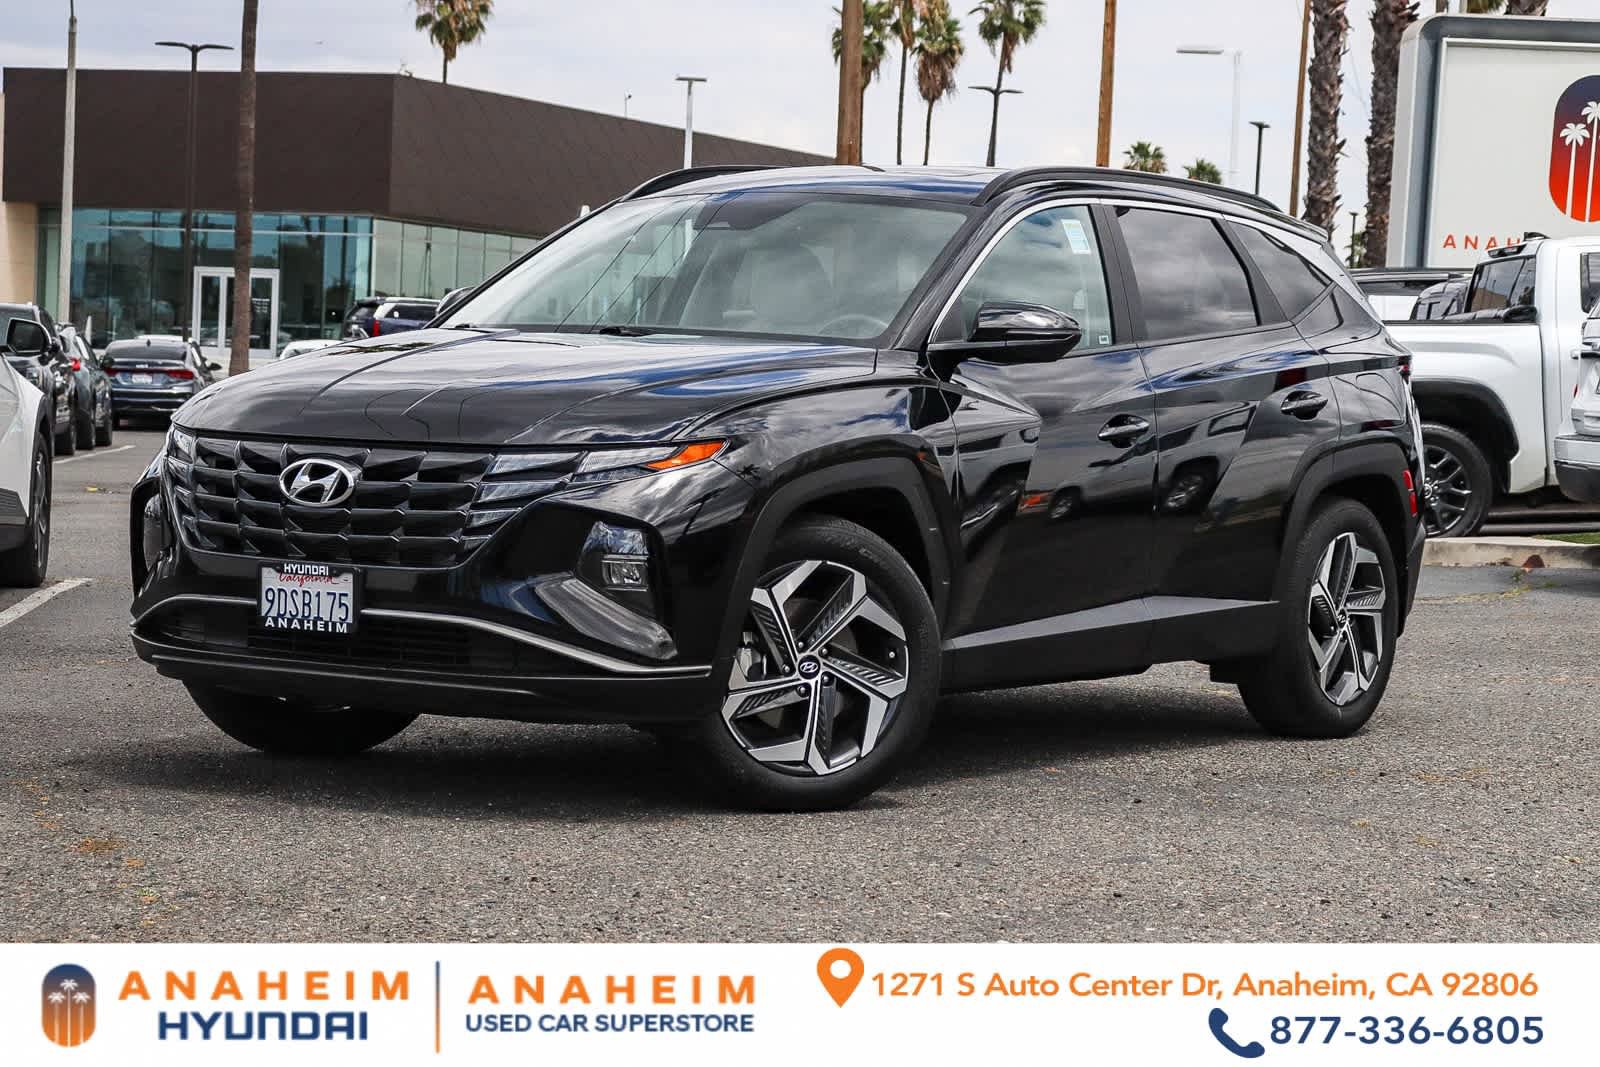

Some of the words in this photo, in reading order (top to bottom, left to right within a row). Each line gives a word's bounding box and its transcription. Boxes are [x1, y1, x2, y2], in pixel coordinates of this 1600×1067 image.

[284, 563, 329, 576] HYUNDAI
[265, 588, 349, 622] 9DSB175
[265, 617, 347, 633] ANAHEIM
